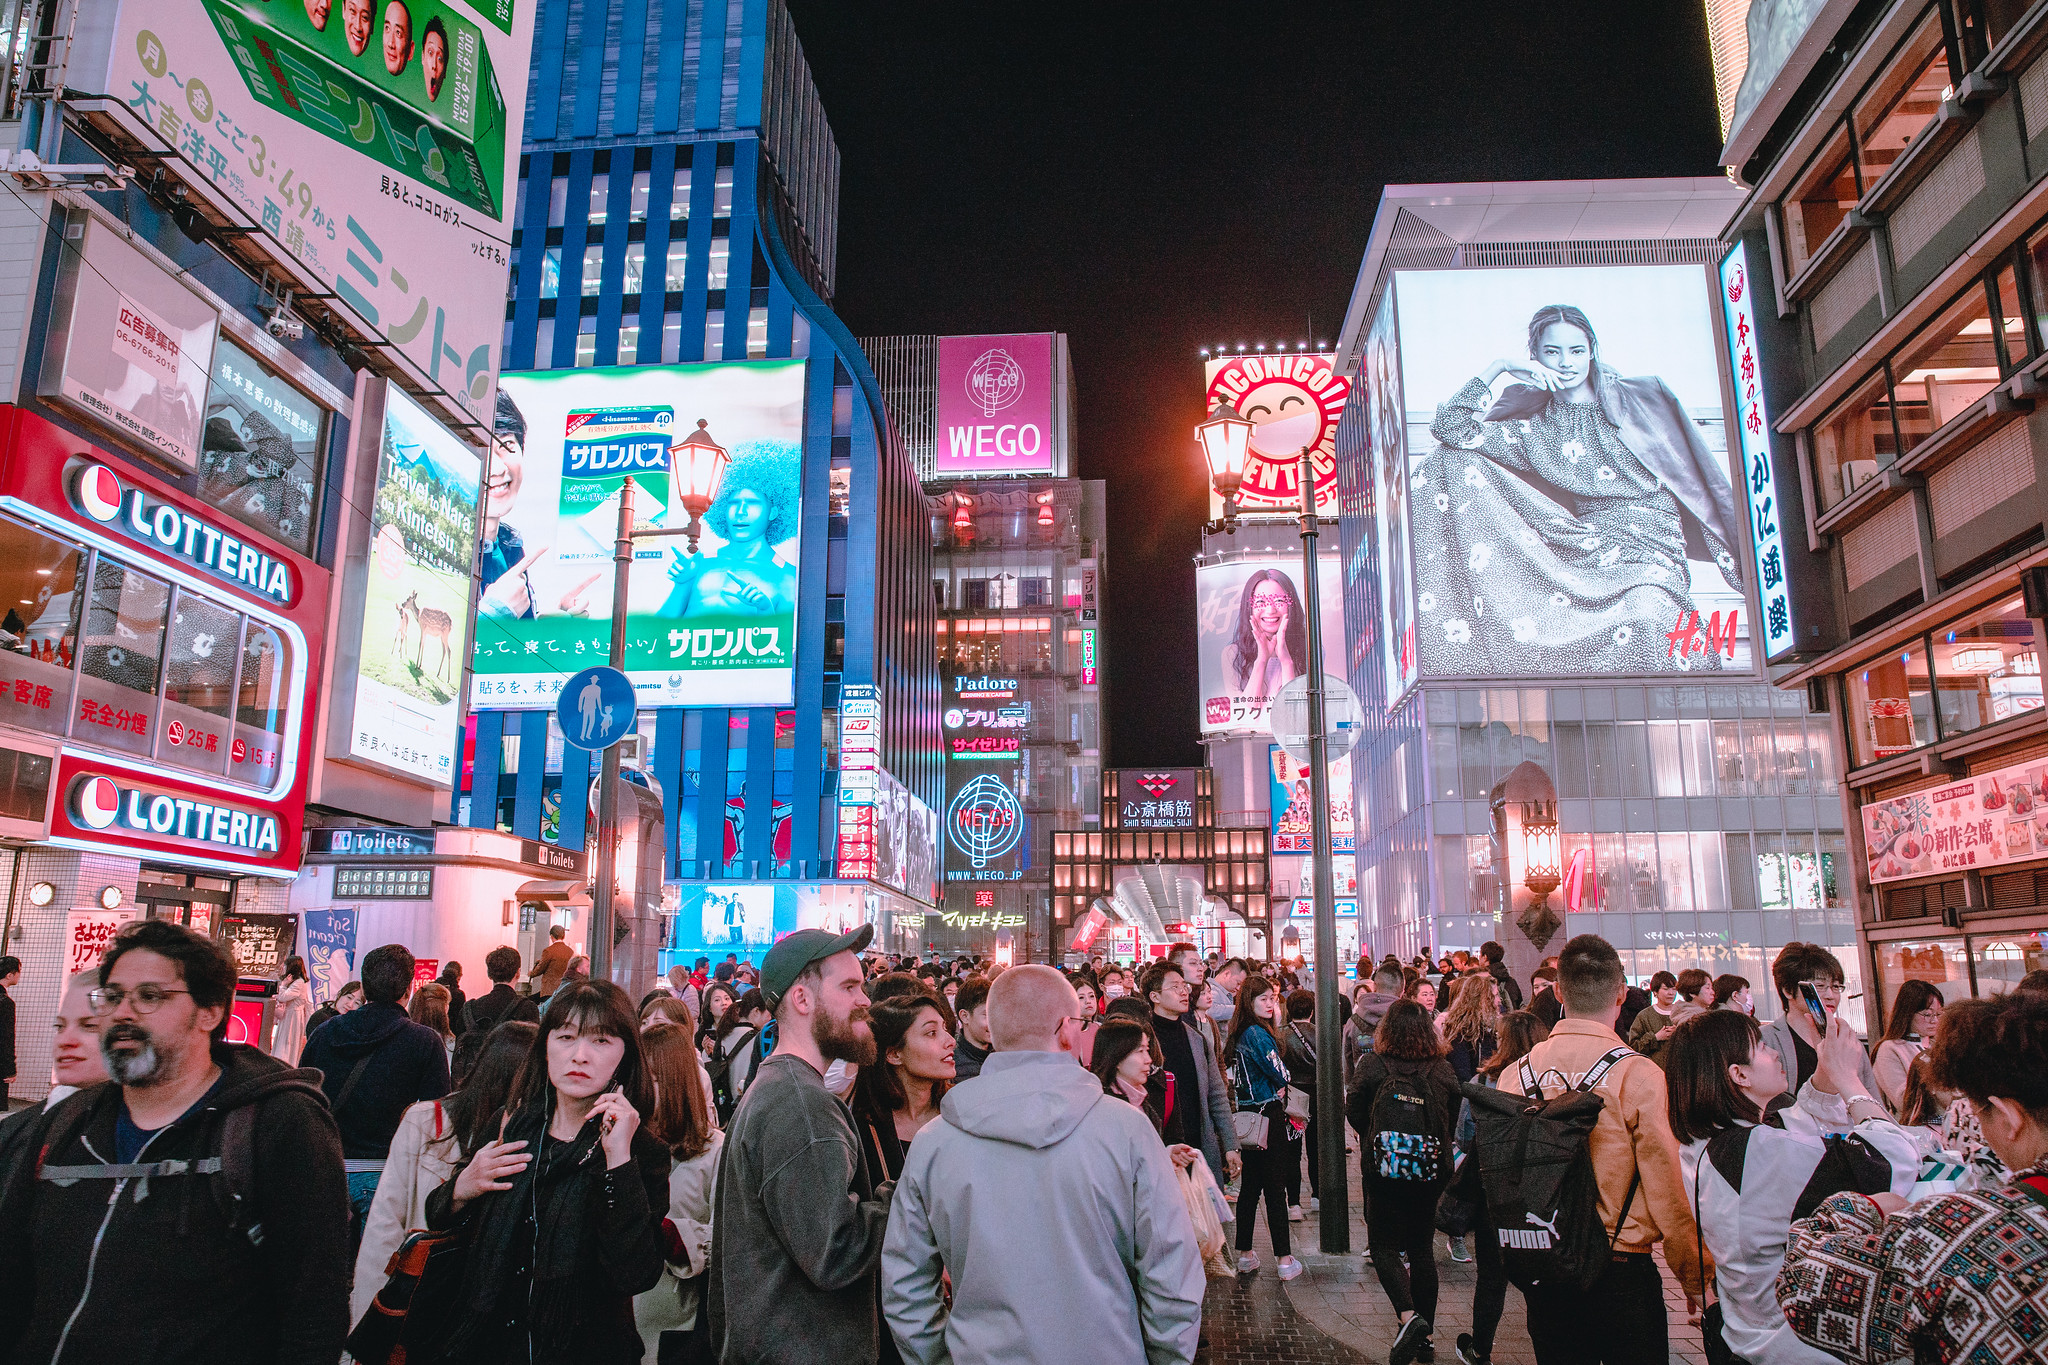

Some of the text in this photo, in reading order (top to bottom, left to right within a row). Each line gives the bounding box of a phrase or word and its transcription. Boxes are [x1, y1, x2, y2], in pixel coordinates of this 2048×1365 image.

[128, 79, 229, 182] 大吉洋平
[118, 307, 179, 357] 広告募集中
[116, 328, 177, 374] 06-6766-2016
[657, 414, 670, 424] 40
[948, 423, 1041, 458] WEGO
[570, 443, 665, 470] サロンパス
[380, 497, 395, 515] on
[386, 453, 471, 535] Travel to Nara
[131, 490, 289, 602] LOTTERIA
[667, 627, 781, 659] サロンパス
[1666, 609, 1738, 659] H&M
[13, 678, 54, 710] 客席
[955, 676, 1018, 692] J'adore
[80, 698, 148, 736] 完全分煙
[187, 728, 219, 753] 25席
[952, 737, 1019, 752] サイゼリヤ
[128, 789, 279, 852] LOTTERIA
[959, 809, 1014, 827] WE GO
[1123, 800, 1192, 818] 心斎橋筋
[857, 806, 870, 871] インターネット
[1278, 821, 1312, 834] スタッ
[1921, 818, 1994, 856] の新作会席
[355, 834, 411, 850] Toilets
[842, 834, 854, 871] コミック
[549, 850, 575, 870] Toilets
[947, 870, 1023, 881] WWW.WEGO.JP
[976, 890, 994, 907] 薬
[942, 911, 1028, 931] マツモトキヨシ
[1498, 1228, 1552, 1249] PUMA
